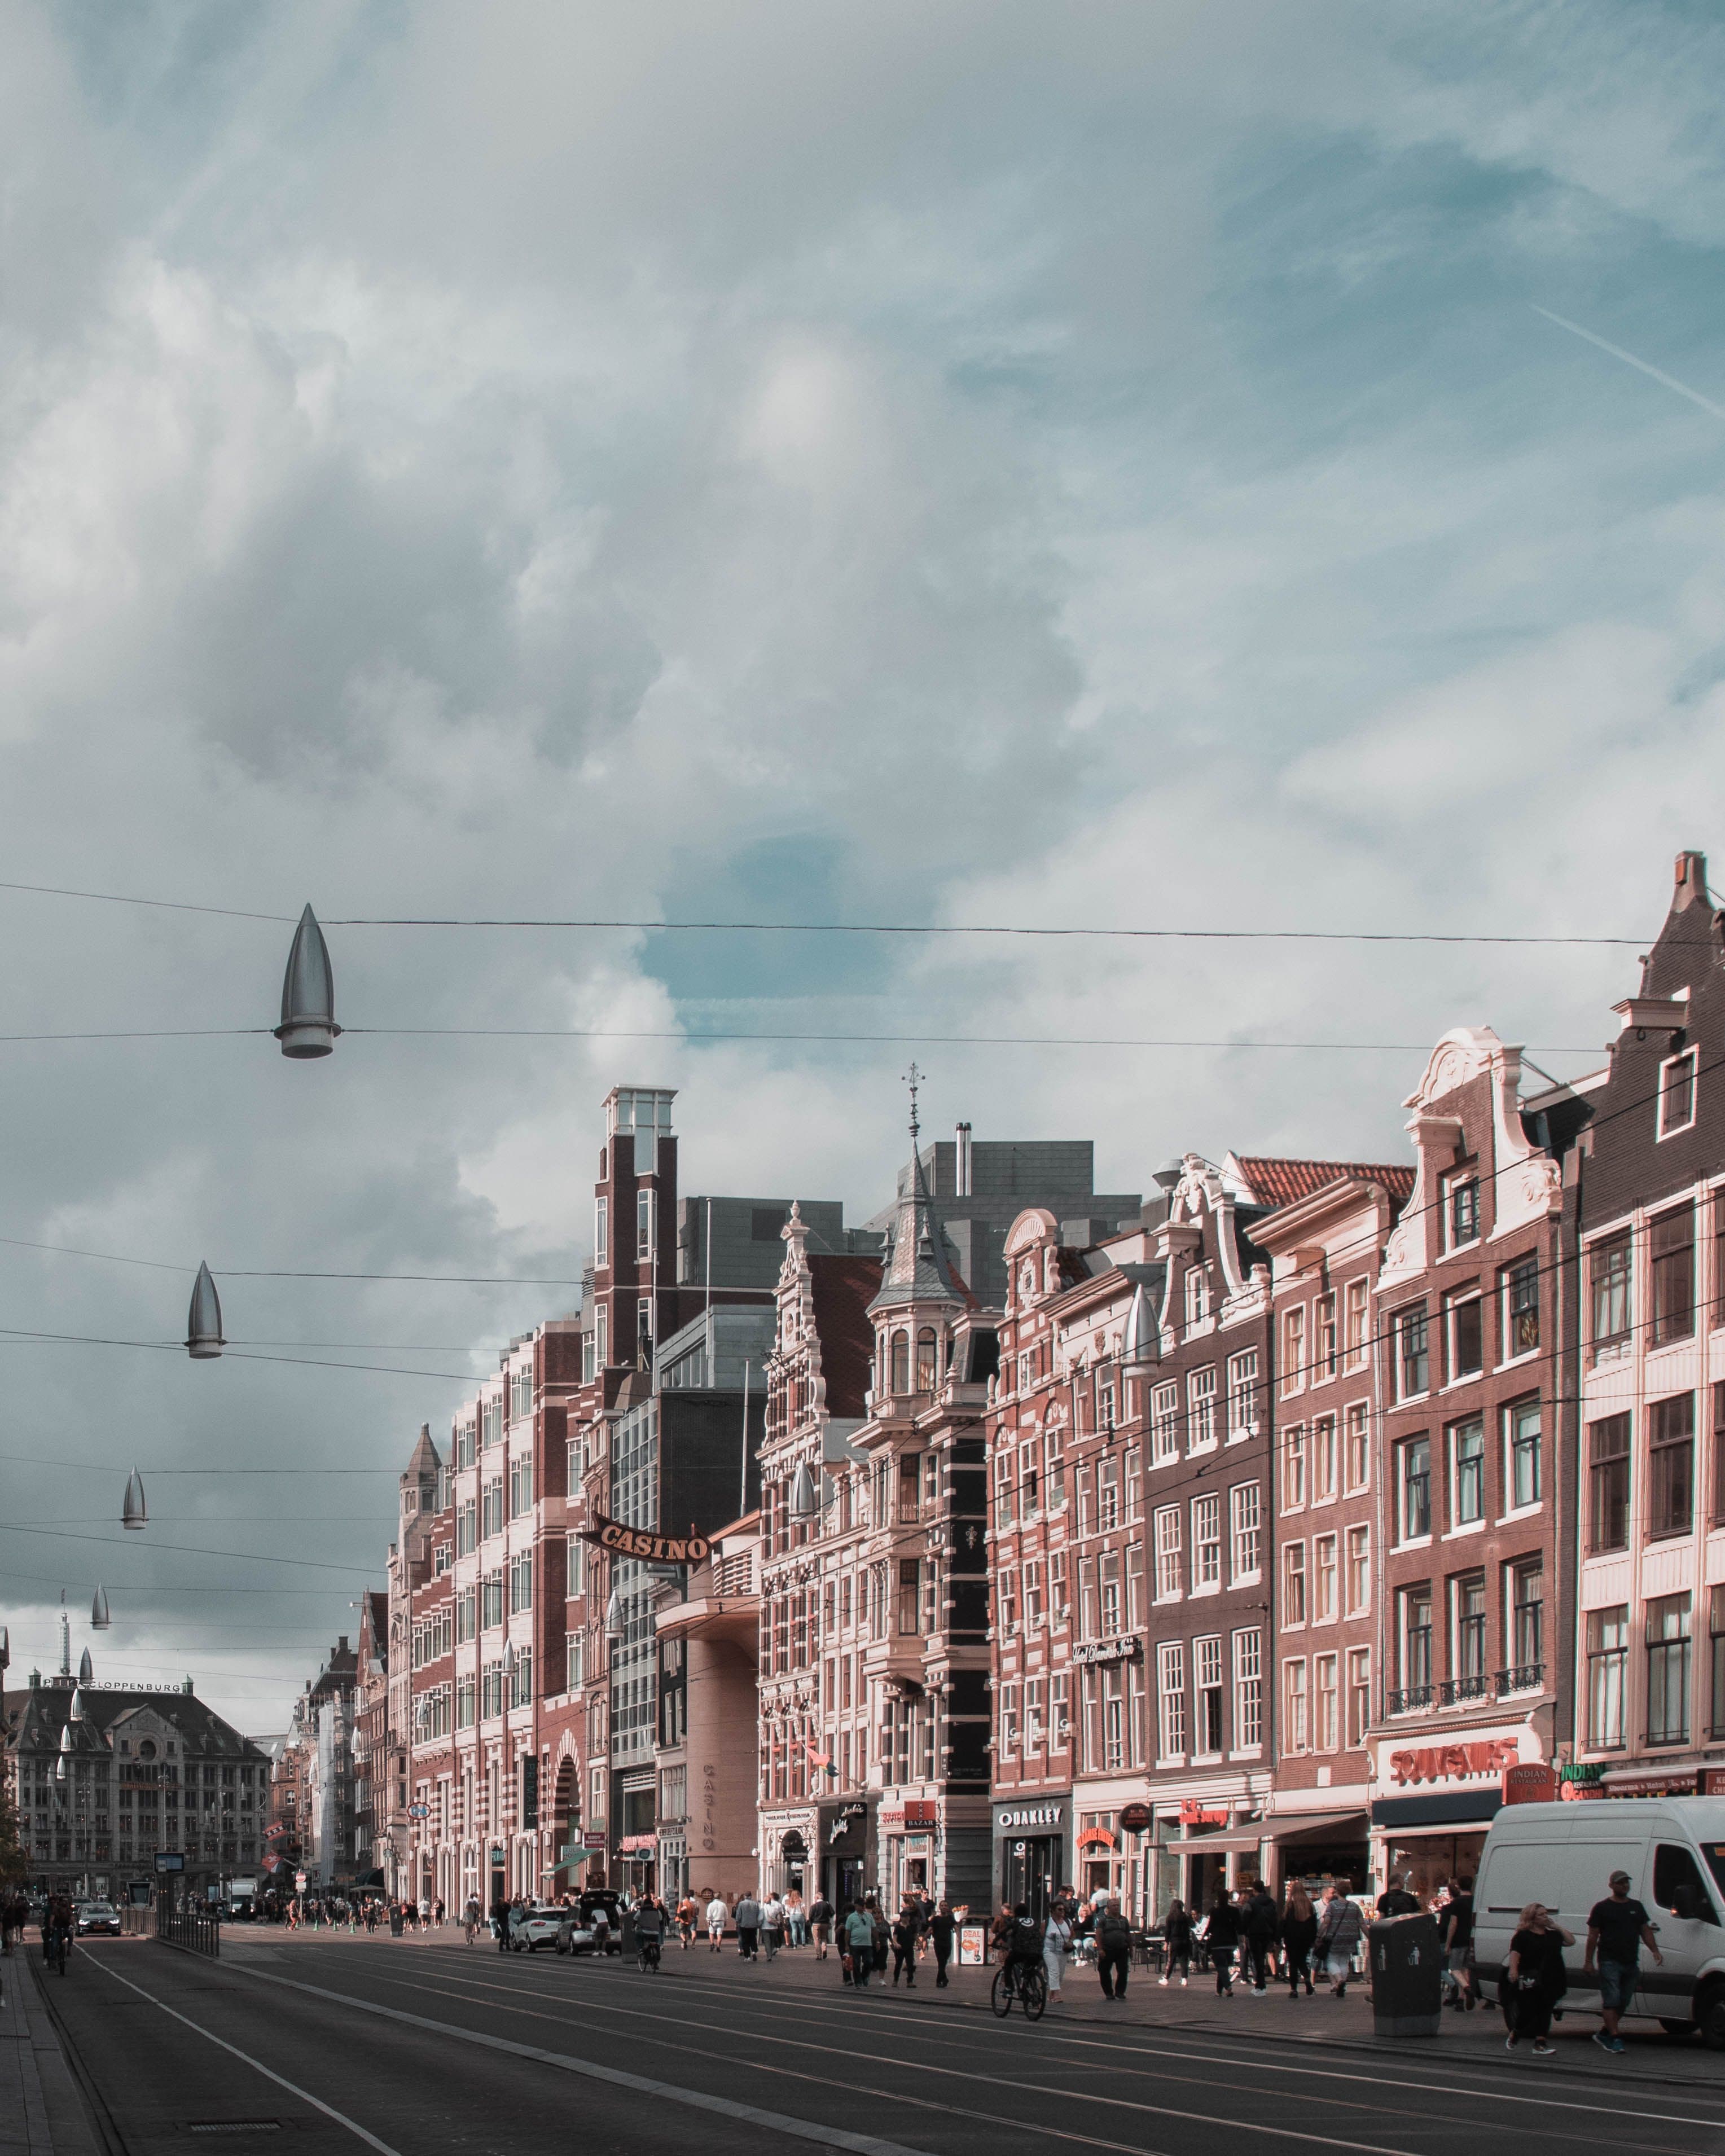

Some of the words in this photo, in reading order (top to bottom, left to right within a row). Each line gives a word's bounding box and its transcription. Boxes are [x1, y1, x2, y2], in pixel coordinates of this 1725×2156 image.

[601, 1525, 708, 1559] CASINO
[90, 1681, 180, 1692] CLOPPENBURG
[1514, 1769, 1547, 1778] INDIAN
[1561, 1762, 1606, 1781] INDIAN
[526, 1763, 536, 1822] PRIMARK
[1608, 1784, 1639, 1792] Shoarma
[703, 1764, 714, 1850] CASINO
[1013, 1807, 1061, 1825] OAKLEY
